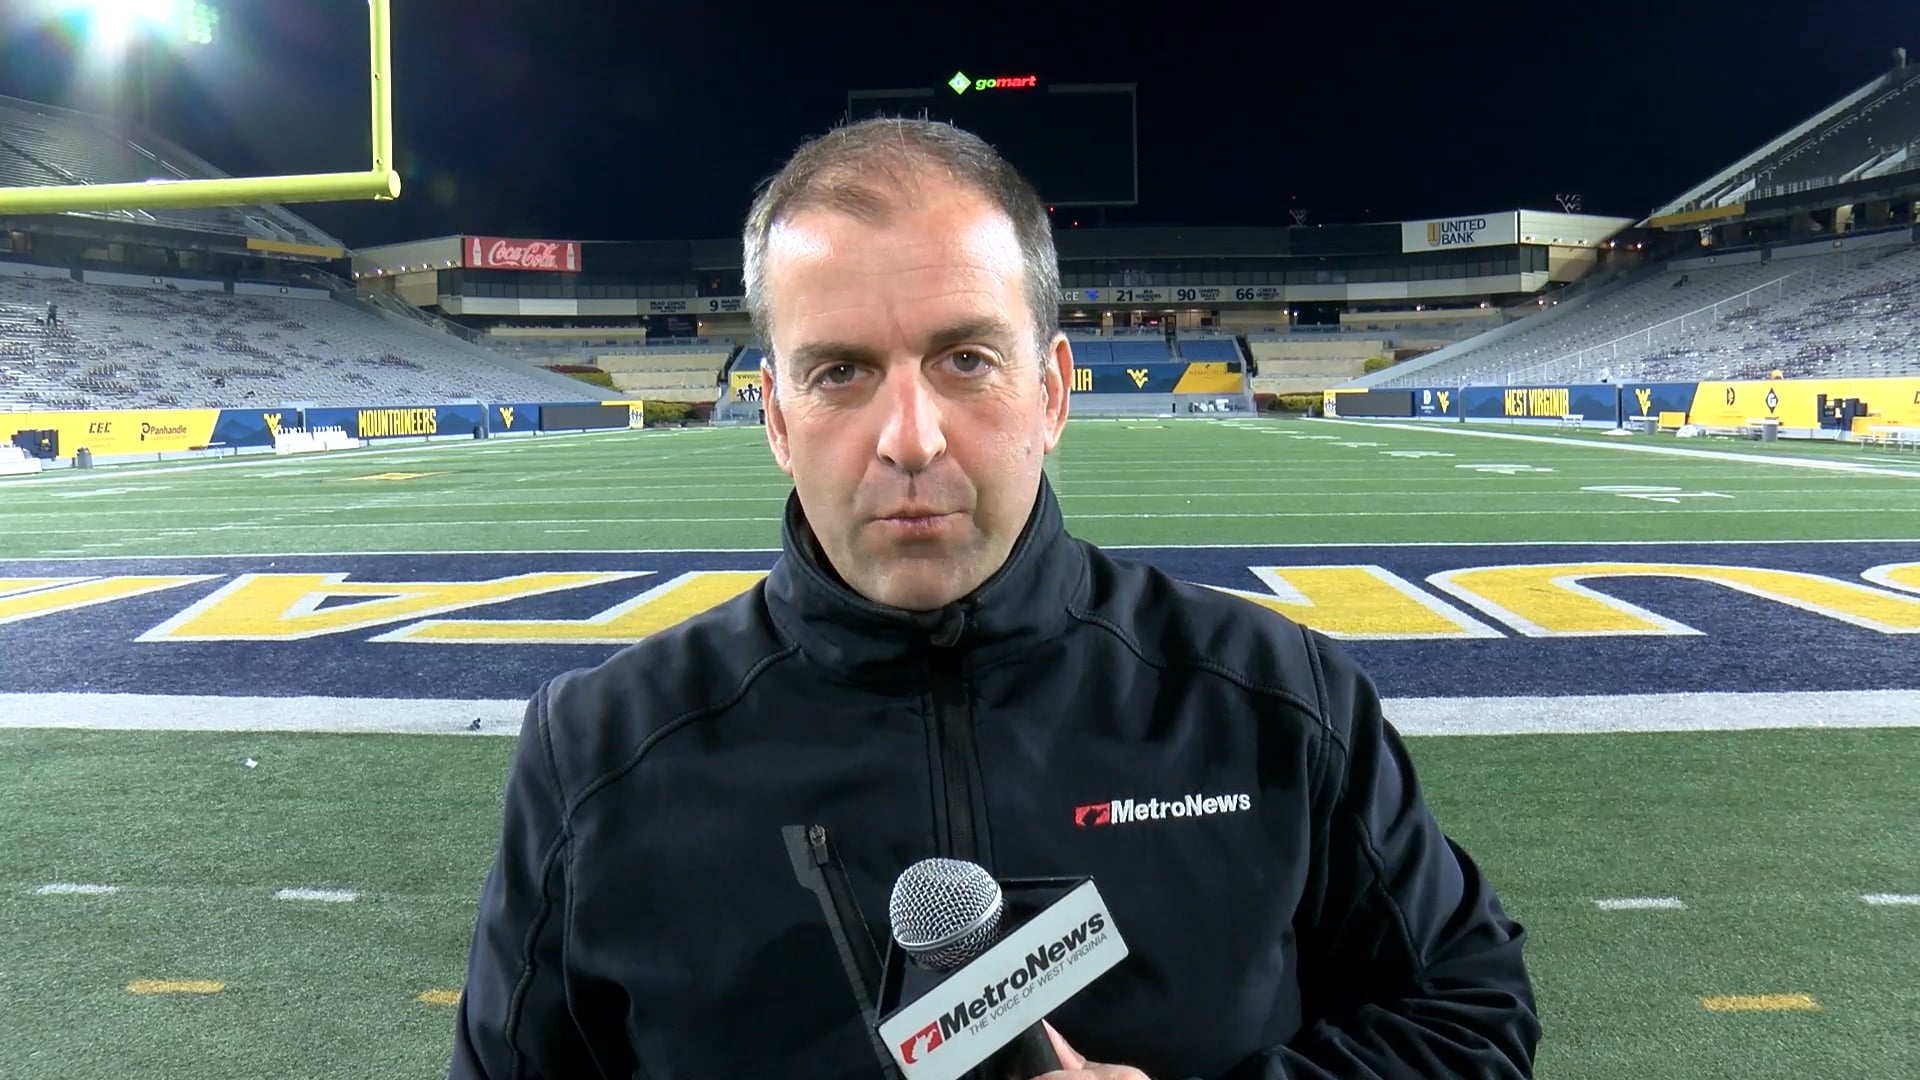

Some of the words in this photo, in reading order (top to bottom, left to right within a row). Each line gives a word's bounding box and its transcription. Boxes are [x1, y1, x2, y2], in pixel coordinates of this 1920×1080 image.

[975, 75, 1037, 90] gomart
[1441, 218, 1487, 233] UNITED
[1441, 231, 1475, 245] BANK
[488, 240, 559, 268] Coca-Cola
[1116, 290, 1133, 302] 21
[1177, 288, 1196, 301] 90
[1235, 288, 1254, 301] 66
[709, 300, 719, 312] 9
[1504, 389, 1528, 416] WEST
[1528, 388, 1569, 416] VIRGINIA
[150, 425, 187, 435] Panhandle
[358, 408, 437, 437] MOUNTAINEERS
[1111, 794, 1251, 825] MetroNews
[939, 913, 1105, 1040] MetroNews
[969, 1016, 989, 1036] THE
[990, 996, 1021, 1021] VOICE
[1022, 983, 1036, 998] OF
[1036, 964, 1065, 988] WEST
[1066, 932, 1108, 966] VIRGINIA
